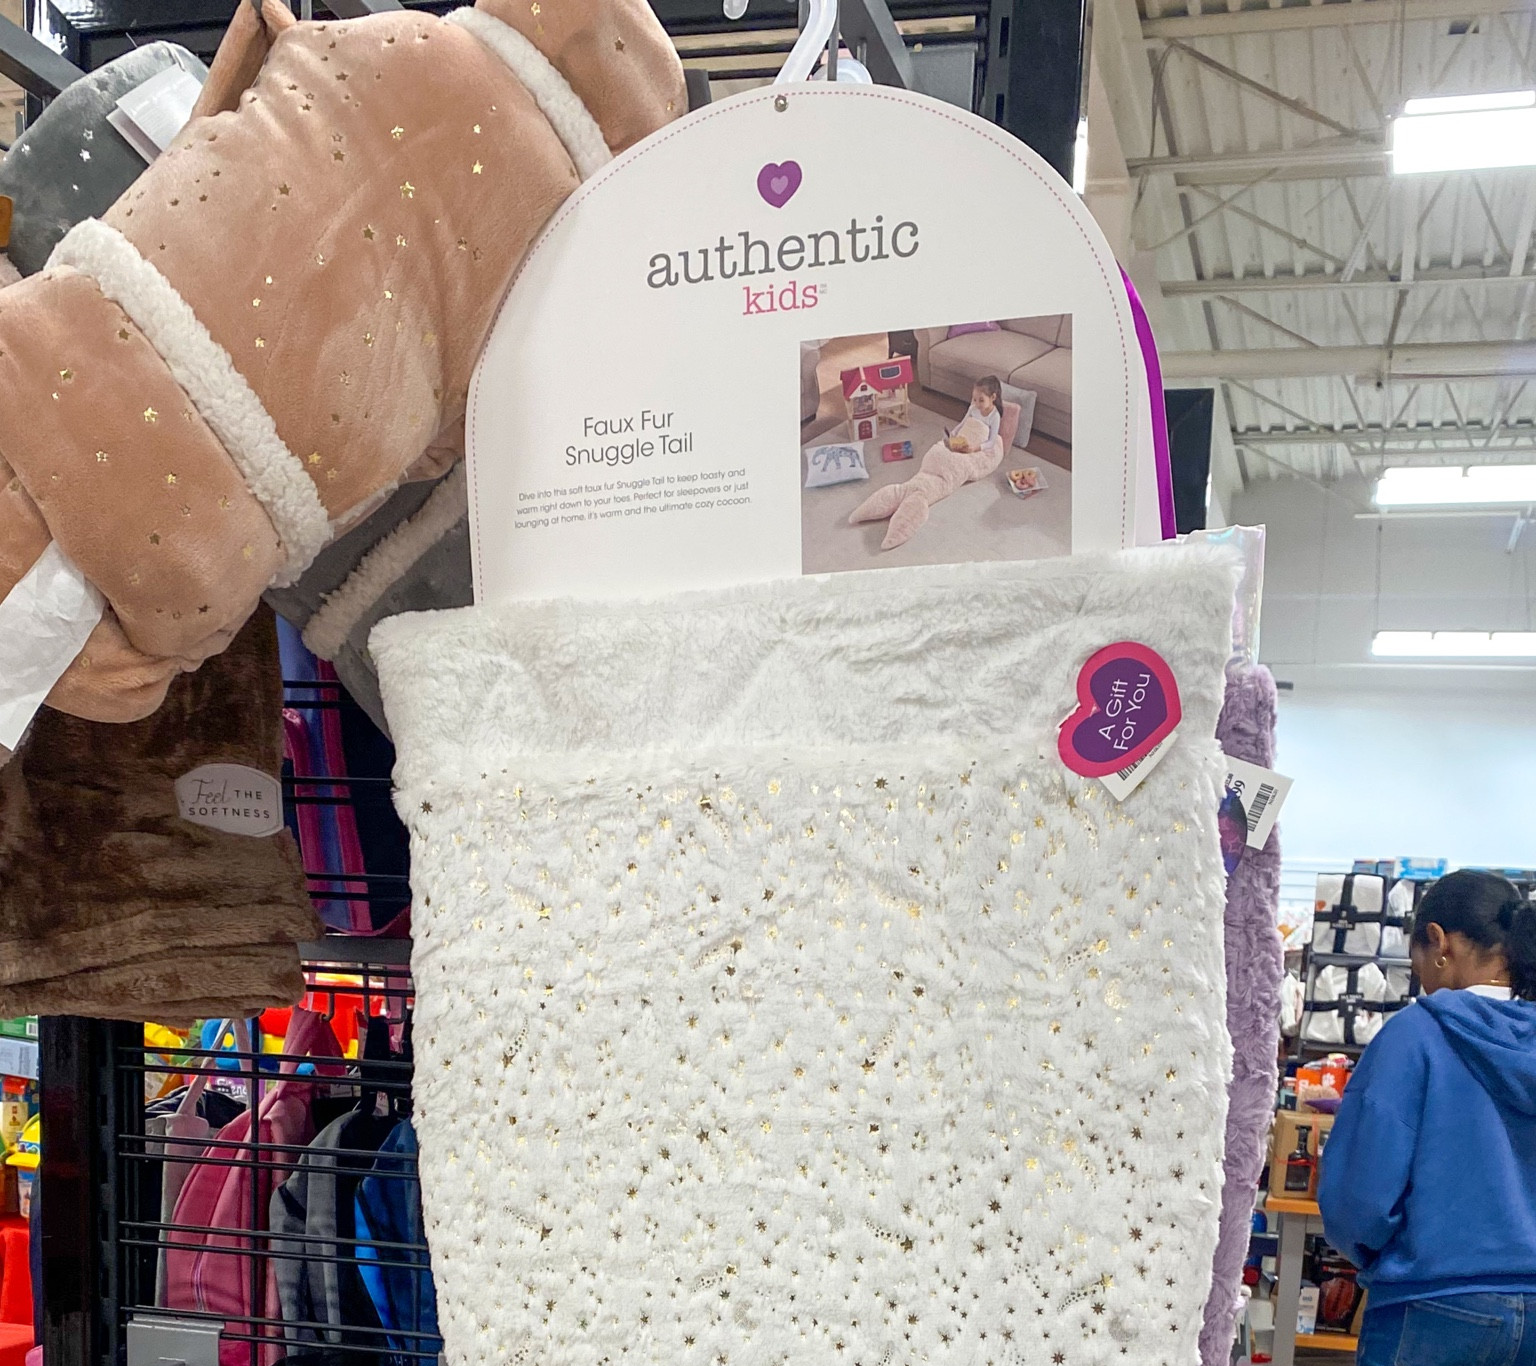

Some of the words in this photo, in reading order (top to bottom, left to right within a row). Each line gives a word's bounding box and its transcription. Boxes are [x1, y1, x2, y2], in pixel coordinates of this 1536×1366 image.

[647, 215, 919, 289] authentic
[742, 281, 818, 315] kids
[584, 417, 634, 437] Faux
[641, 410, 674, 430] Fur
[565, 438, 654, 466] Snuggle
[658, 432, 693, 455] Tail
[516, 506, 538, 515] warm
[540, 502, 557, 513] right
[559, 500, 582, 510] down
[584, 498, 592, 507] to
[594, 497, 611, 508] your
[633, 491, 661, 501] Perfect
[663, 489, 675, 498] for
[677, 485, 721, 497] sleepovers
[723, 484, 732, 492] or
[733, 481, 749, 493] just
[518, 492, 535, 501] Dive
[537, 490, 552, 499] into
[553, 488, 567, 497] this
[568, 486, 583, 495] soft
[584, 484, 602, 494] faux
[604, 482, 614, 491] fur
[616, 478, 650, 489] Snuggle
[652, 476, 665, 485] Tail
[667, 476, 675, 484] to
[677, 473, 698, 483] keep
[700, 470, 725, 480] toasty
[727, 468, 746, 478] and
[514, 517, 550, 529] lounging
[551, 516, 559, 525] at
[600, 509, 623, 518] warm
[624, 507, 641, 516] and
[643, 505, 657, 513] the
[659, 501, 693, 512] ultimate
[695, 500, 714, 509] cozy
[1105, 678, 1128, 717] Gift
[1113, 717, 1137, 751] For
[1125, 673, 1151, 713] You
[1099, 724, 1116, 740] A
[190, 777, 228, 805] Feel
[233, 789, 263, 800] THE
[188, 806, 270, 819] SOFTNESS
